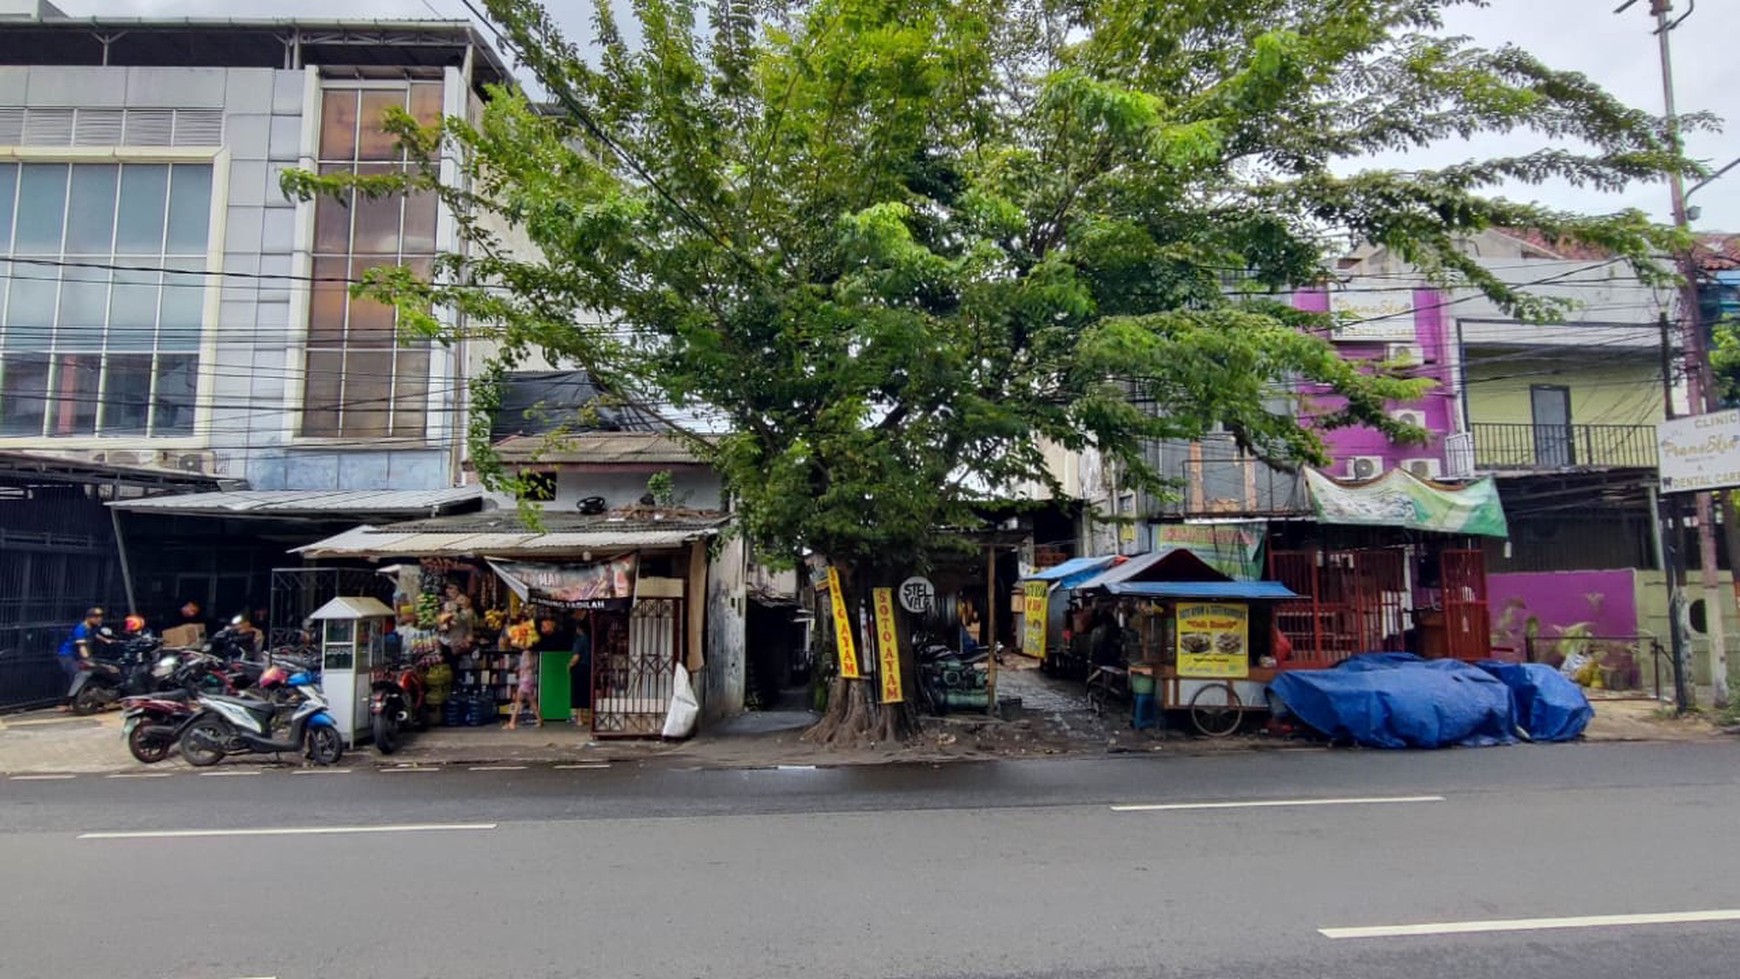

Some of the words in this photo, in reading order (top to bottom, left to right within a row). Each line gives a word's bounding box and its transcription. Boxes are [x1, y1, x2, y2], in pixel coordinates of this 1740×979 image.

[1695, 413, 1737, 429] CLINIC
[1673, 475, 1711, 489] DENTAL
[903, 582, 933, 597] STEL
[878, 590, 892, 643] SOTO
[841, 624, 855, 674] AYAM
[884, 646, 899, 699] AYAM
